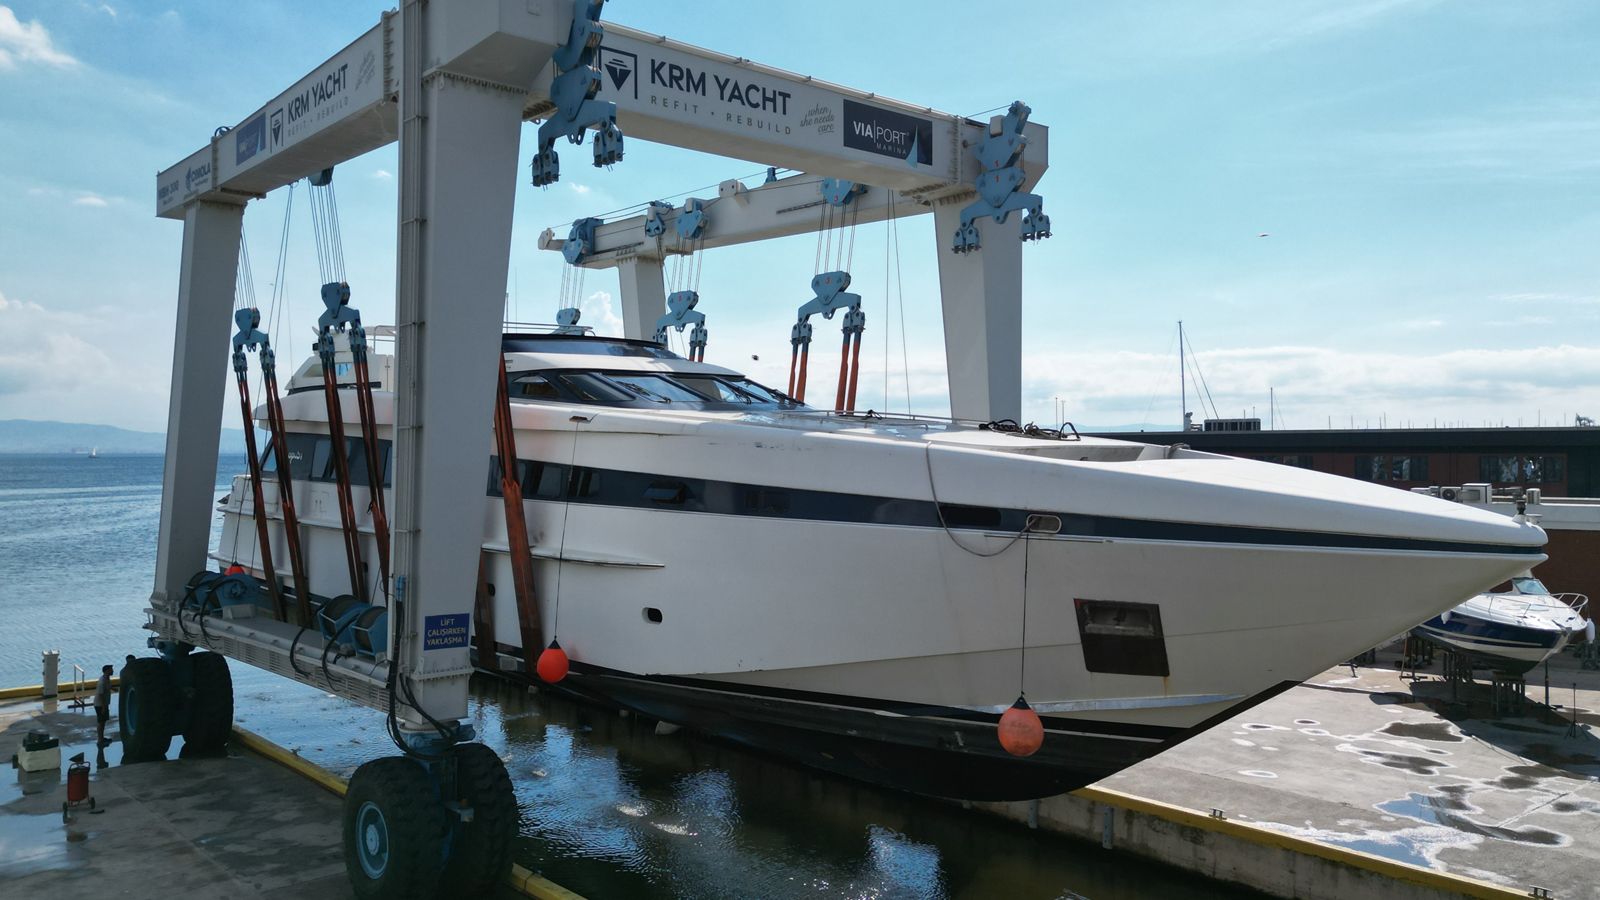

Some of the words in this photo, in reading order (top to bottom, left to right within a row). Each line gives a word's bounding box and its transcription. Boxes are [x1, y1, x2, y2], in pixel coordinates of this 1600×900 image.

[288, 89, 310, 125] KRM
[312, 63, 348, 108] YACHT
[651, 58, 706, 97] KRM
[713, 73, 791, 116] YACHT
[650, 95, 698, 114] REFIT
[726, 112, 791, 135] REBUILD
[808, 103, 830, 117] when
[876, 142, 907, 157] MARINA
